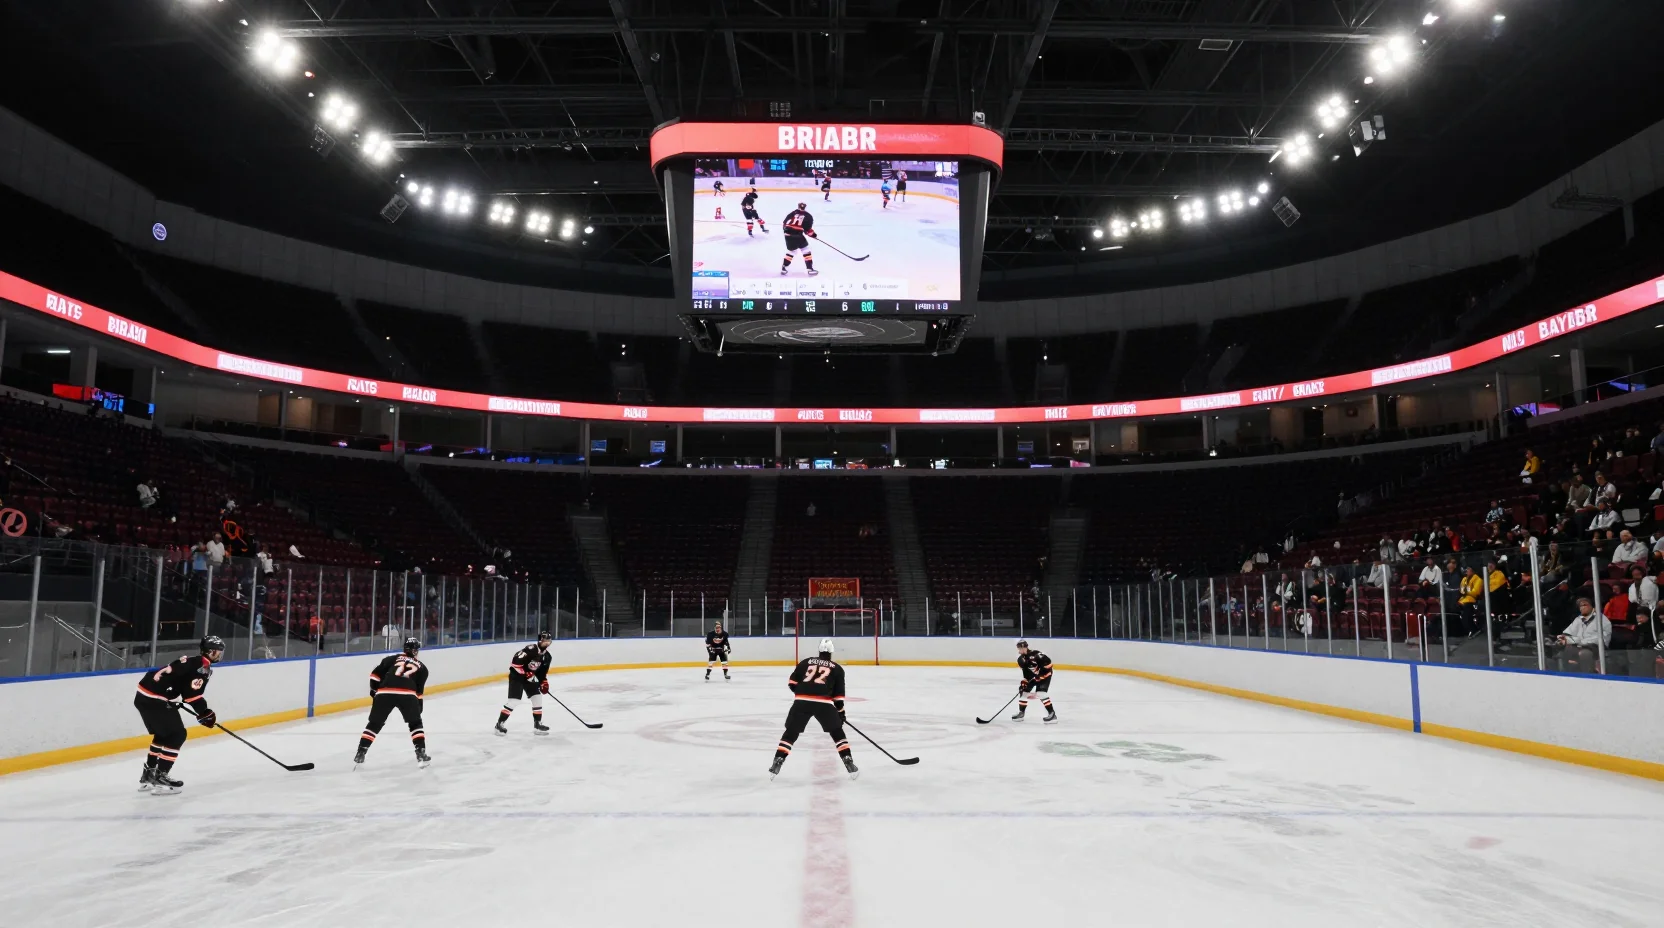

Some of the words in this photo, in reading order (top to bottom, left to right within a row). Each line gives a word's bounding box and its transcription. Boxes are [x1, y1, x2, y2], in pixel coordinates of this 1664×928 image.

[778, 126, 877, 151] BRIABR
[842, 302, 849, 311] 6
[803, 664, 831, 685] 92
